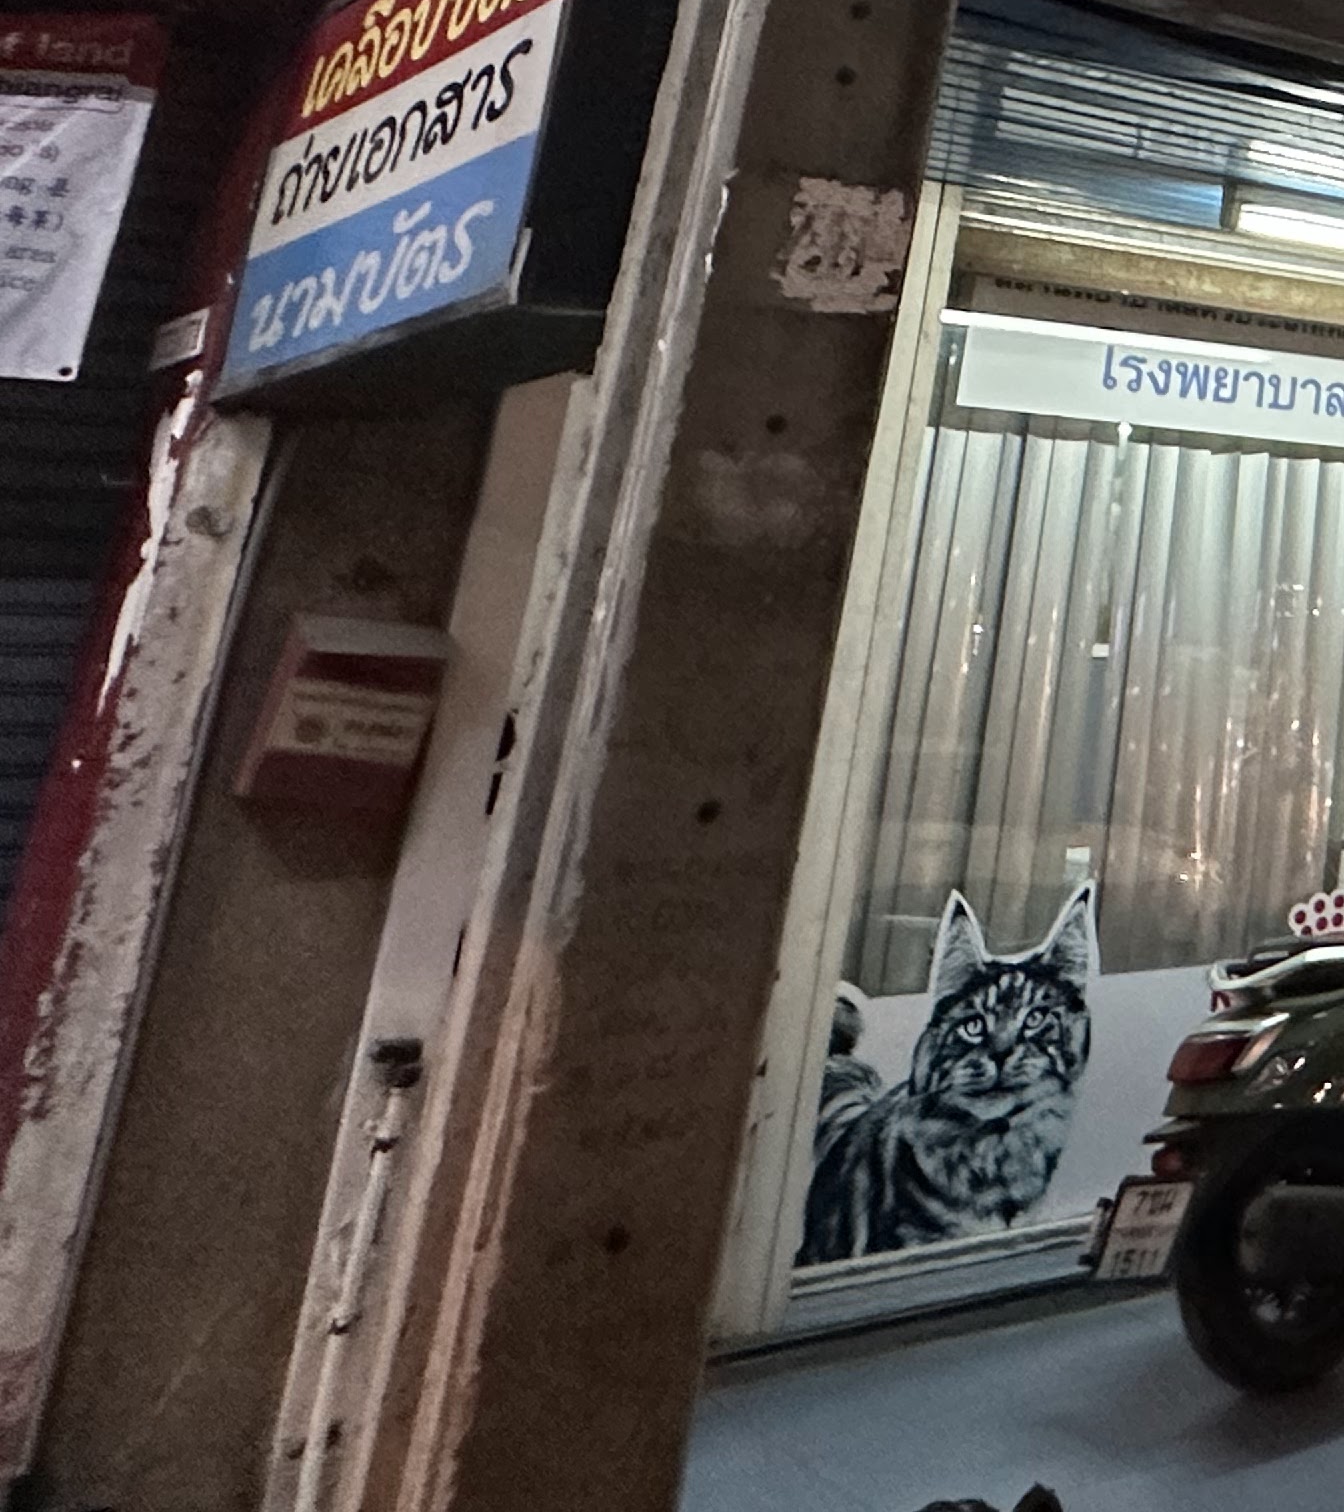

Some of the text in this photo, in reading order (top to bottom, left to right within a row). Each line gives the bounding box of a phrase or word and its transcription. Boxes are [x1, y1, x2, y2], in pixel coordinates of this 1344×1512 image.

[271, 38, 533, 226] ถ่ายเอกสาร
[248, 199, 494, 353] นามบัตร
